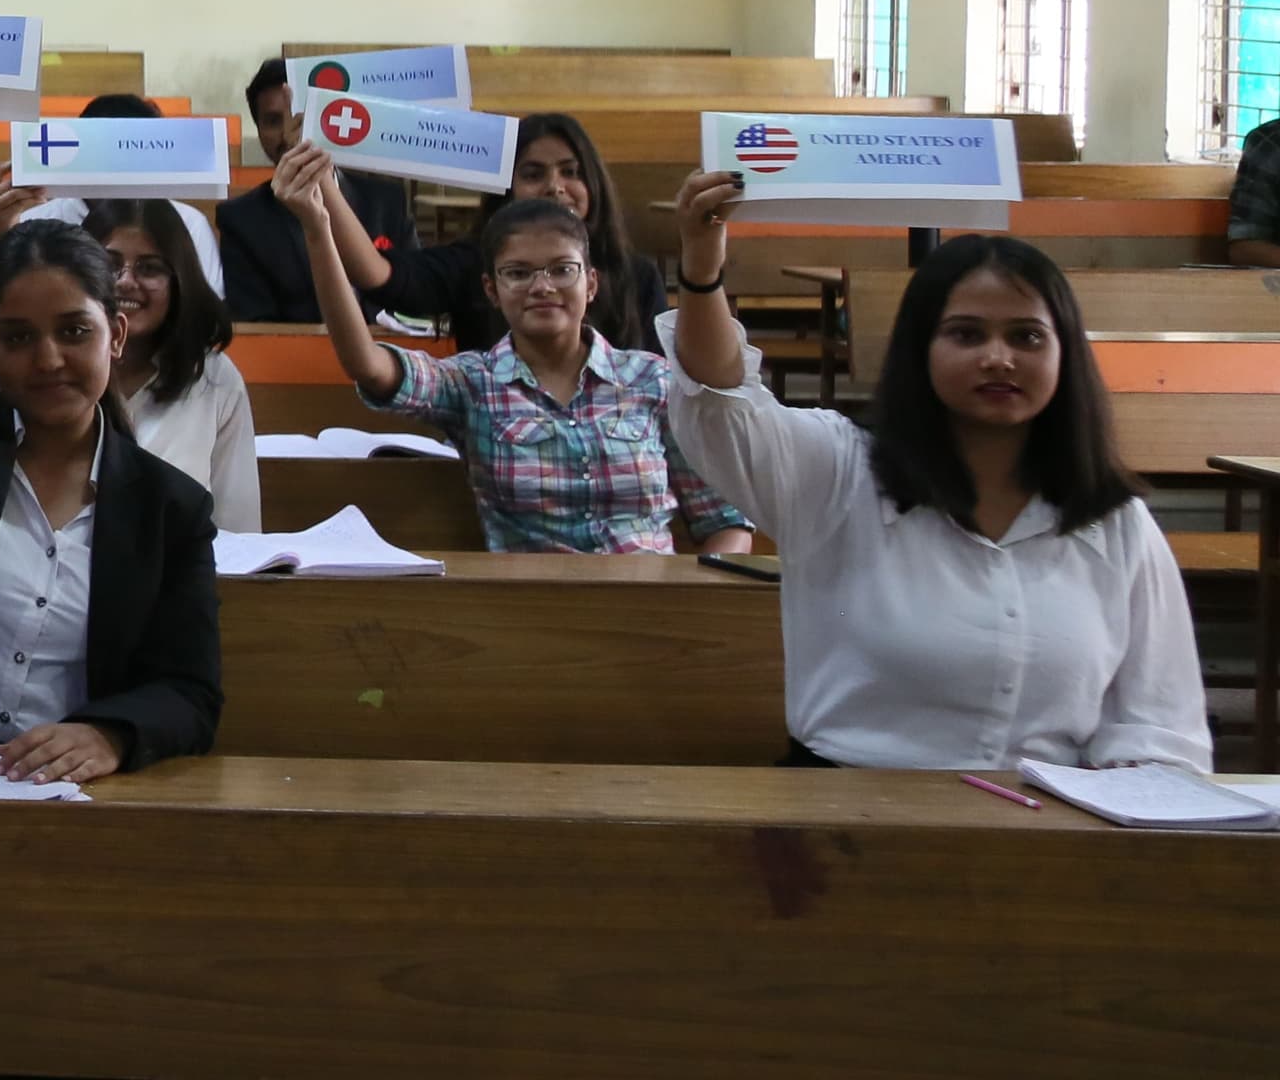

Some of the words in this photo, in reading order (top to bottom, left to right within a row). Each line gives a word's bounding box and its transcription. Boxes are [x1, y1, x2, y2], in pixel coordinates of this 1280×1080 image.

[0, 31, 22, 42] OF
[361, 68, 435, 85] BANGLADESH
[417, 120, 457, 136] SWISS
[117, 138, 175, 150] FINLAND
[380, 131, 490, 157] CONFEDERATION
[809, 133, 880, 146] UNITED
[883, 134, 955, 147] STATES
[958, 135, 985, 148] OF
[855, 152, 943, 166] AMERICA
